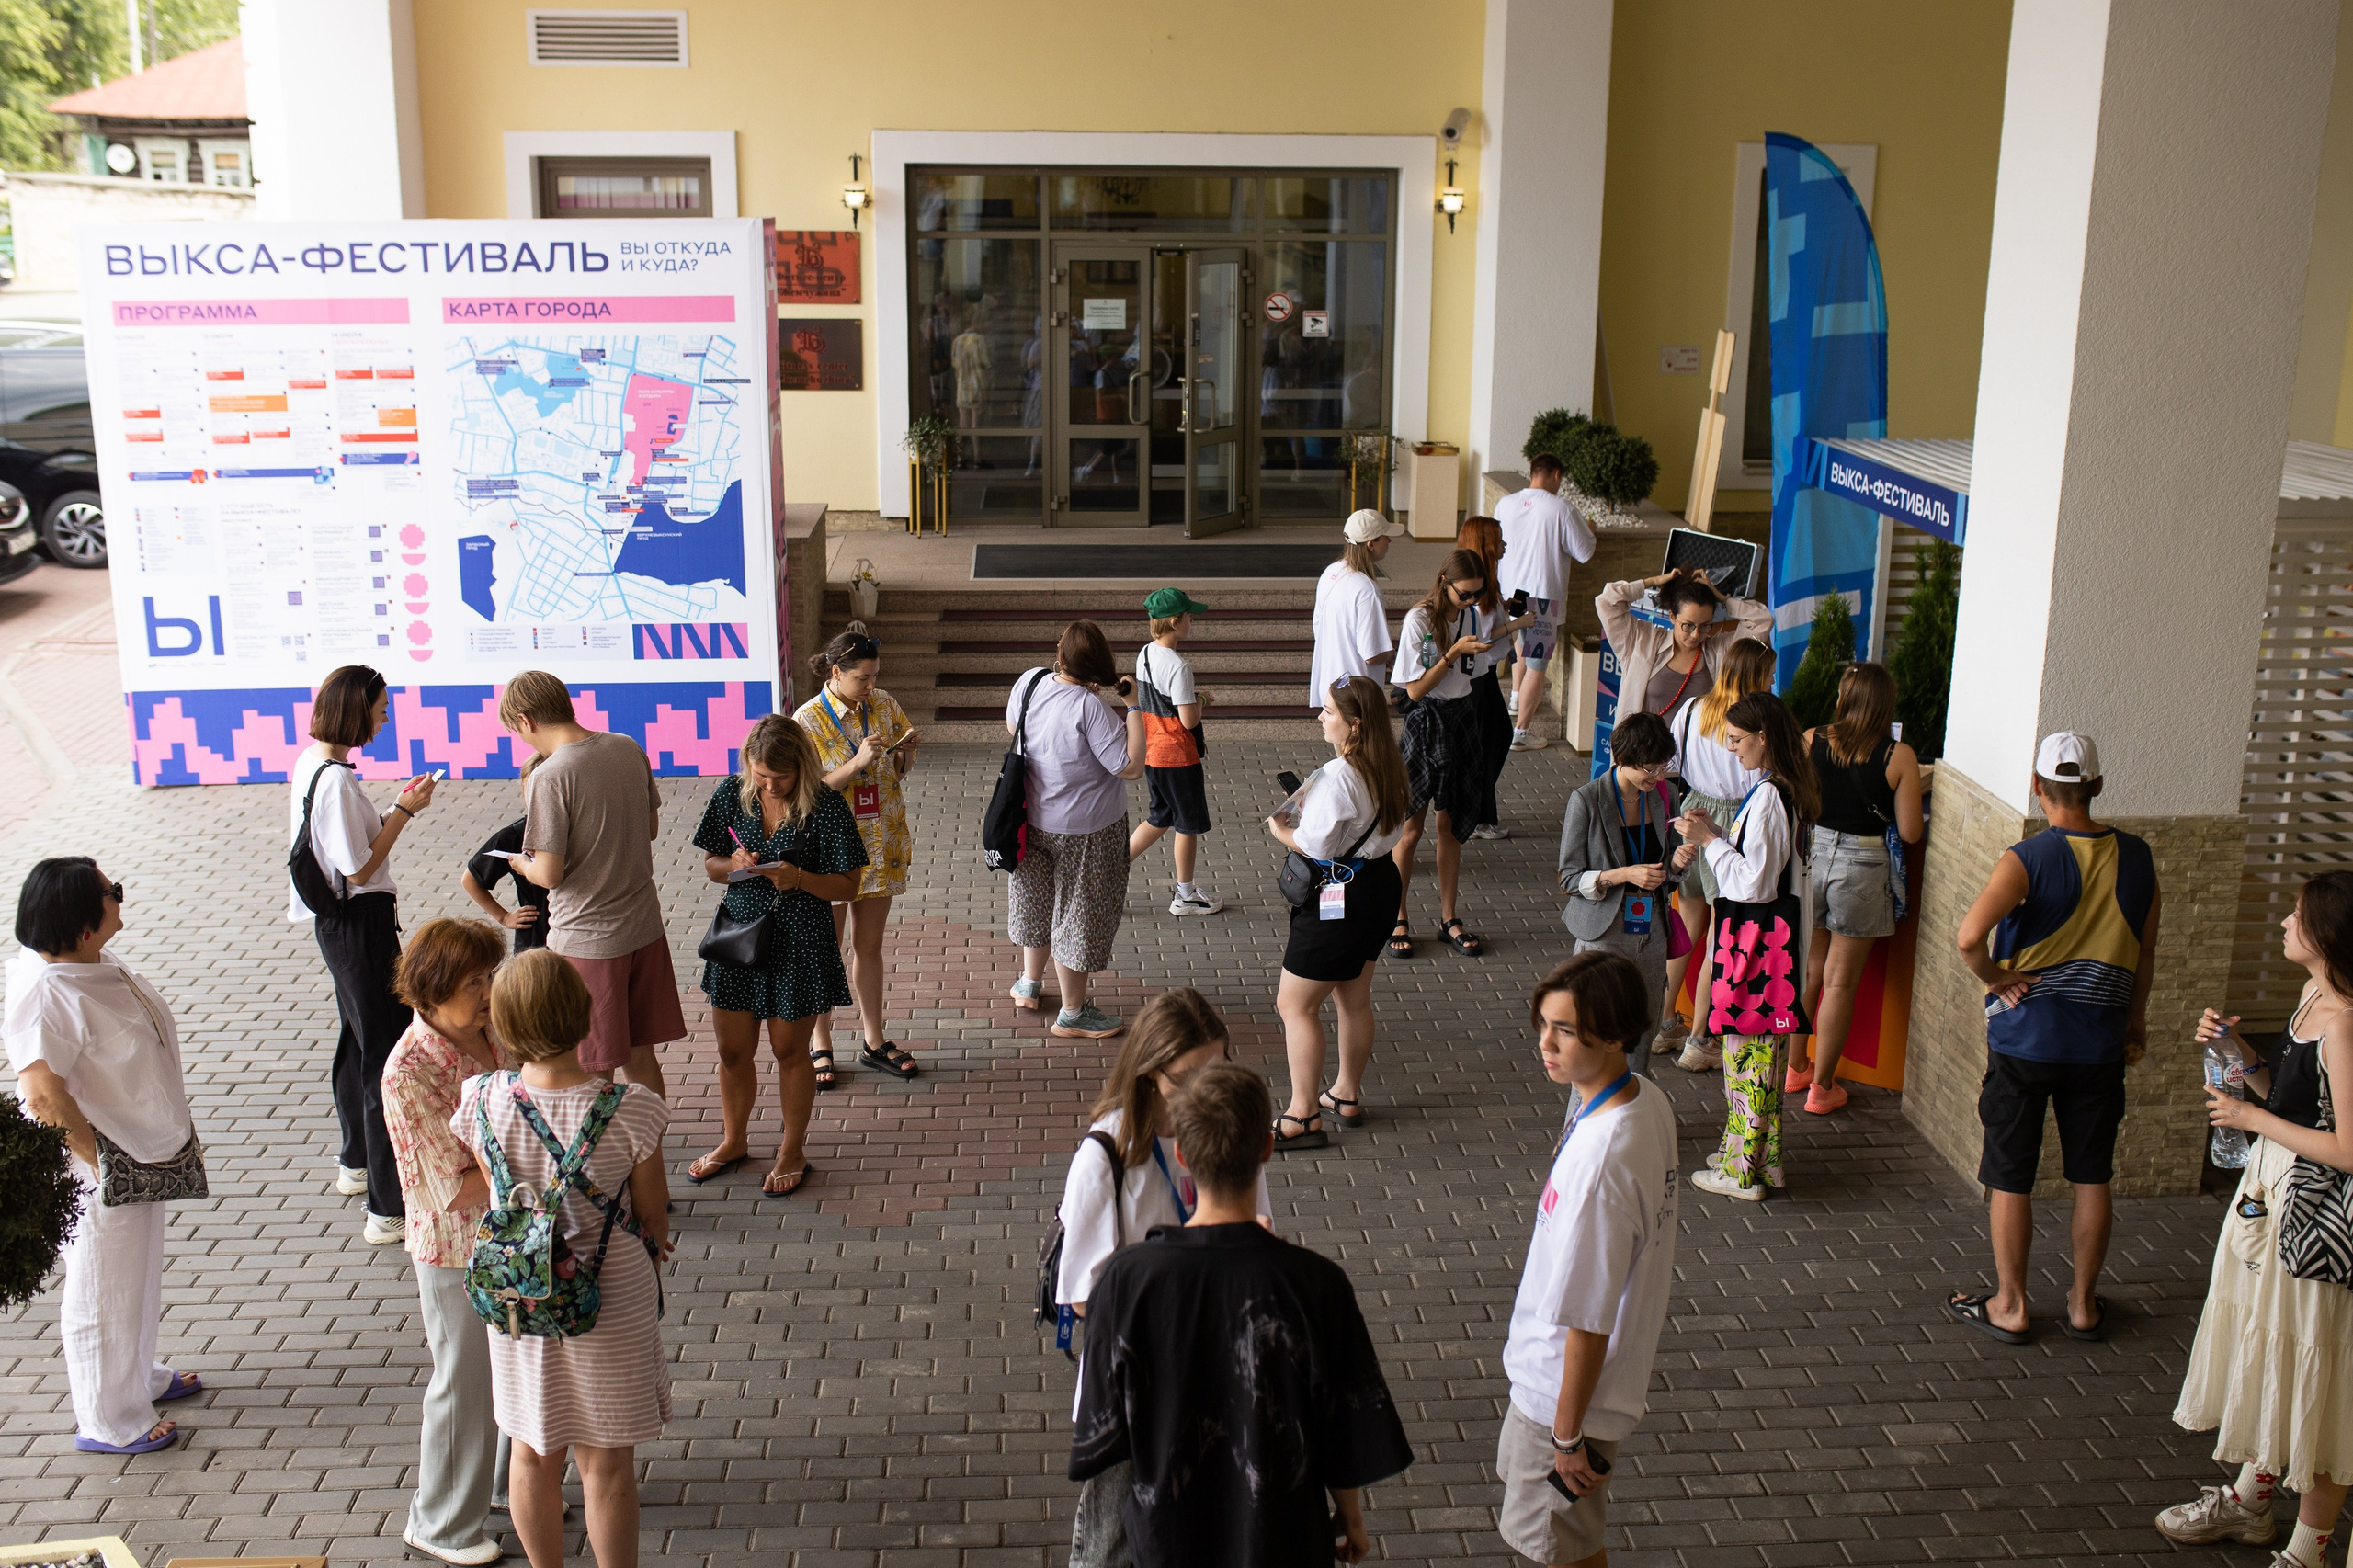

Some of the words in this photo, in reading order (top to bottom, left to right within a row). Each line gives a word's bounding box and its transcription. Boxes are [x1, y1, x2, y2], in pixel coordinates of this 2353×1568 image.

[620, 241, 650, 255] ВЫ
[654, 239, 732, 256] ОТКУДА
[105, 240, 610, 277] ВЫКСА-ФЕСТИВАЛЬ
[620, 260, 636, 273] И
[640, 257, 699, 274] КУДА?
[119, 304, 258, 322] ПРОГРАММА
[449, 302, 519, 318] КАРТА
[524, 301, 612, 318] ГОРОДА
[1830, 462, 1950, 528] ВЫКСА-ФЕСТИВАЛЬ
[142, 594, 226, 658] Ы
[858, 792, 874, 806] Ы
[1775, 1017, 1790, 1028] Ы
